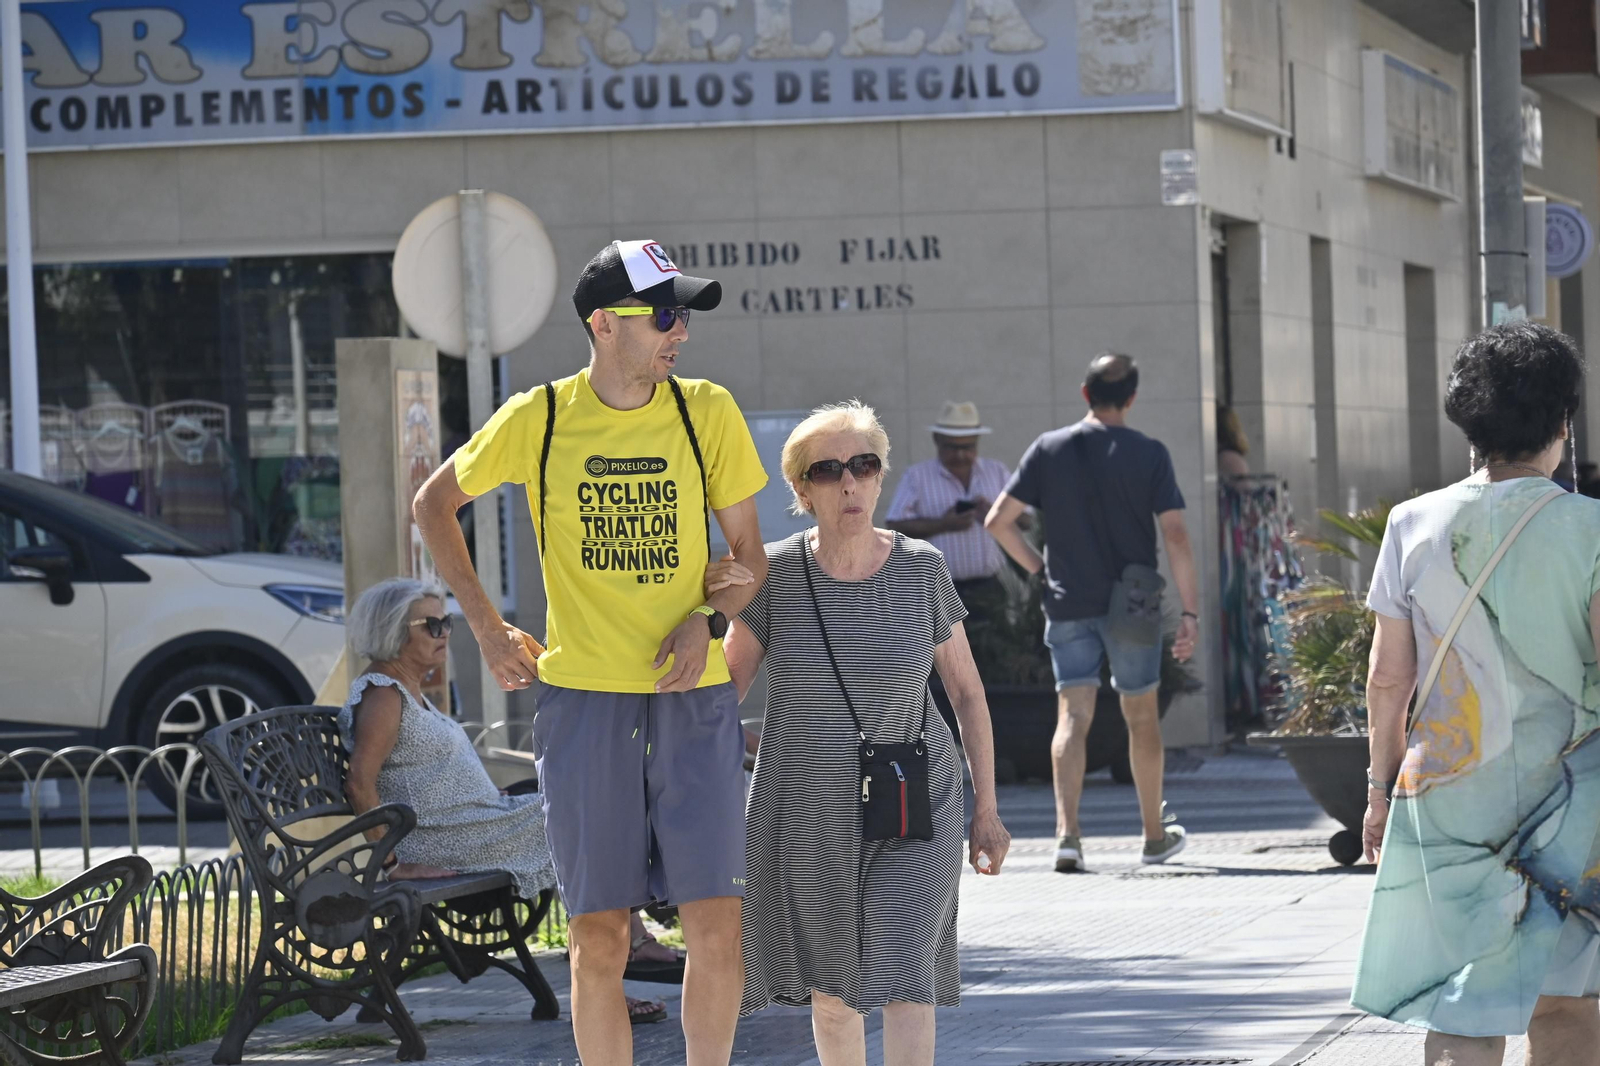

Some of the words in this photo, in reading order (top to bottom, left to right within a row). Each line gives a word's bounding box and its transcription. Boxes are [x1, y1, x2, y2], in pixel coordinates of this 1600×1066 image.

[241, 0, 1046, 80] ESTRELLA
[30, 83, 425, 133] COMPLEMENTOS
[481, 66, 754, 114] ARTÍCULOS
[776, 68, 831, 105] DE
[853, 62, 1042, 102] REGALO
[840, 235, 941, 265] FIJAR
[740, 283, 914, 314] CARTELES
[611, 462, 664, 472] PIXELIO.es
[577, 480, 678, 505] CYCLING
[579, 503, 677, 513] DESIGN
[580, 513, 677, 538] TRIATLON
[581, 539, 677, 548] DESIGN
[581, 546, 679, 571] RUNNING
